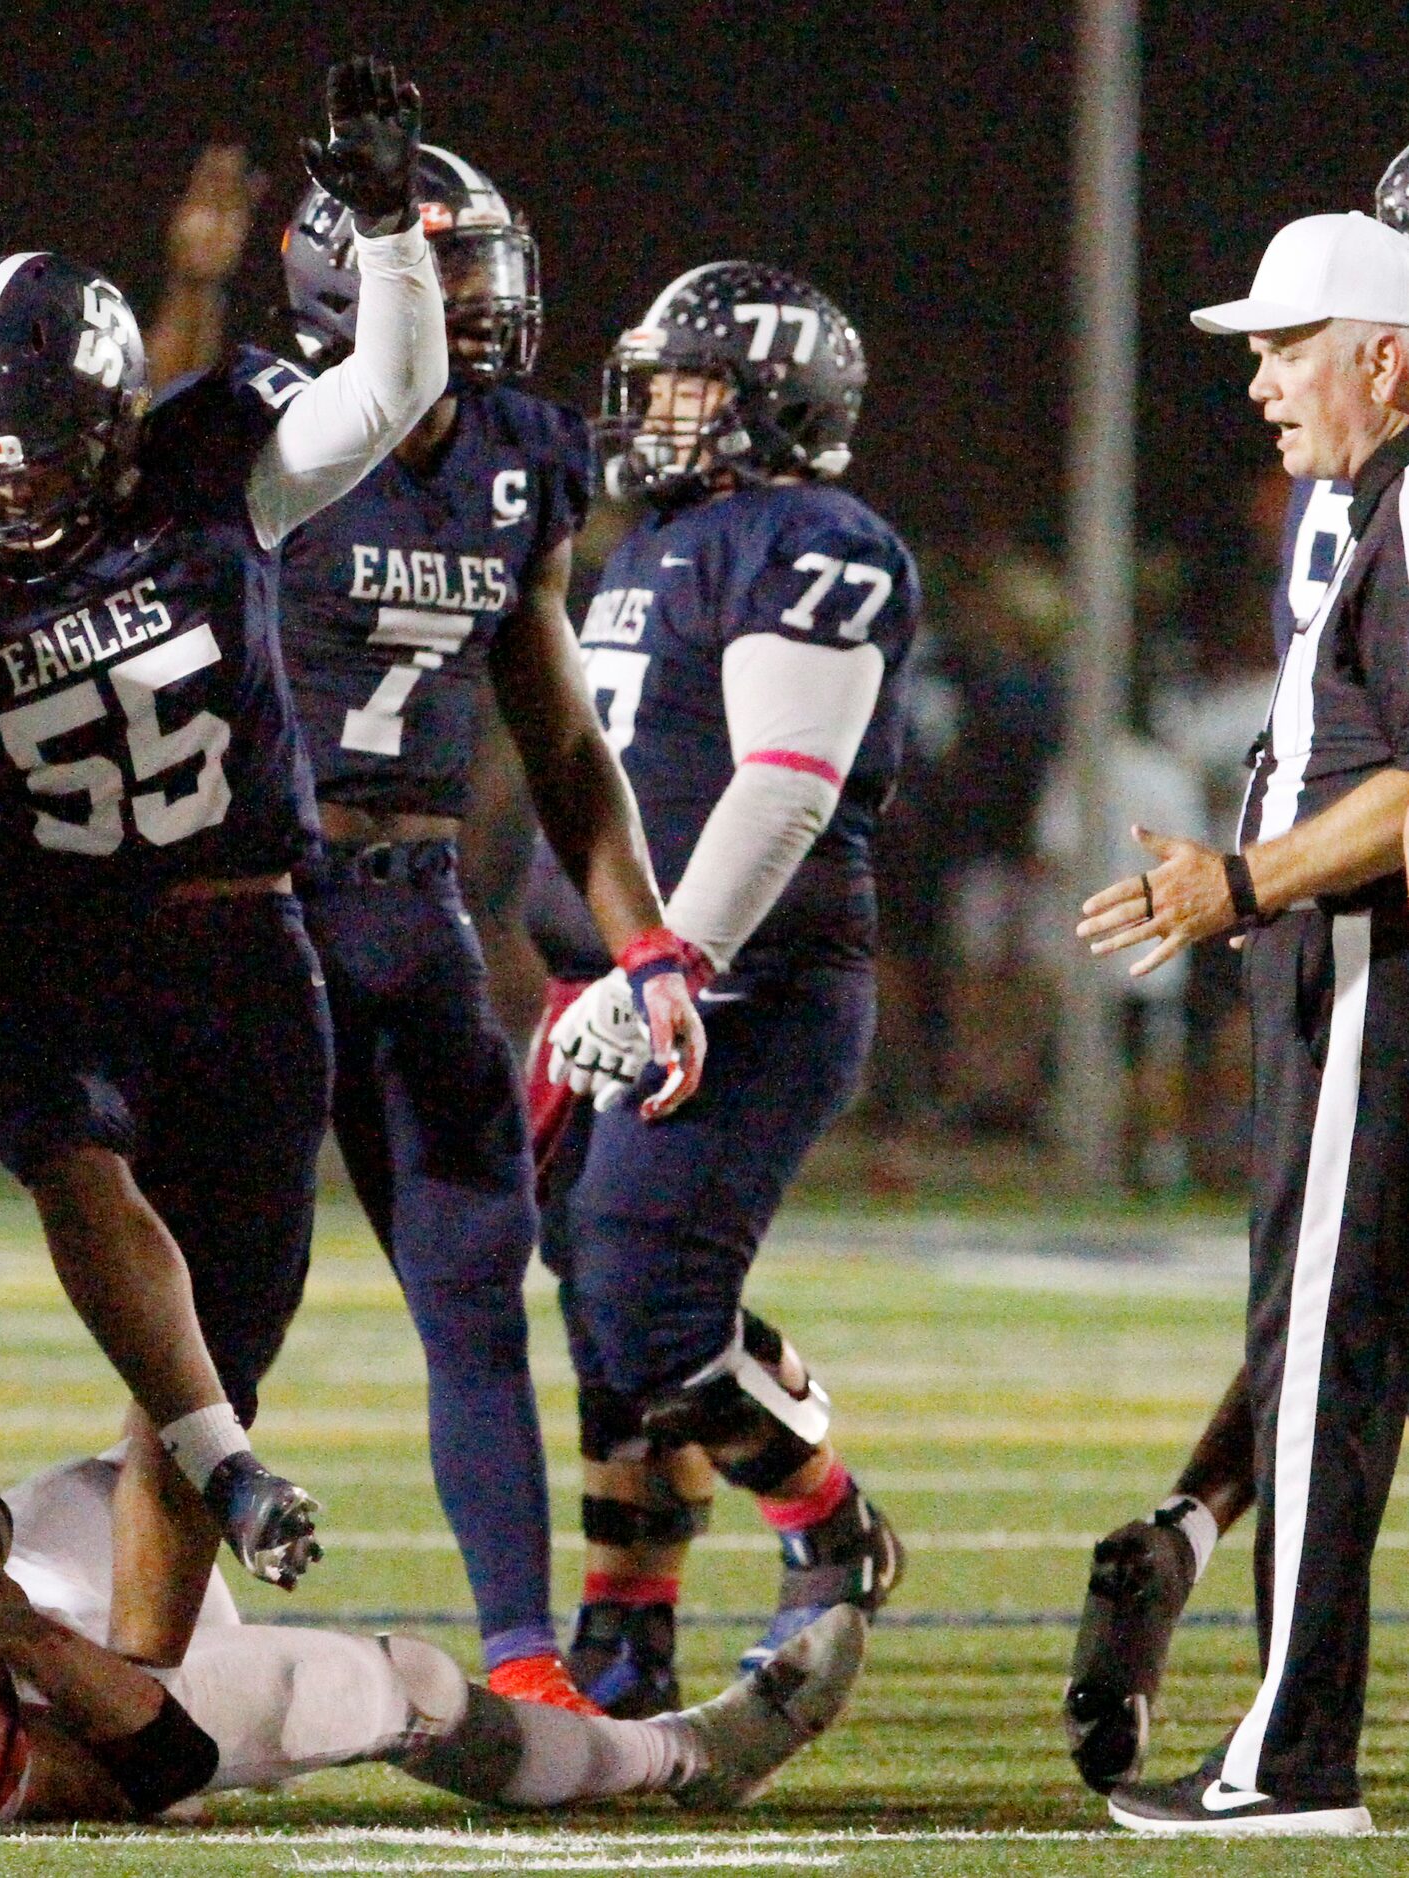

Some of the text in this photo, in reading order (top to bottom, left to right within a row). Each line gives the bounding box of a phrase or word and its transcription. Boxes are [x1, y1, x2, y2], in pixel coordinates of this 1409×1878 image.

[733, 303, 821, 364] 77
[492, 469, 528, 518] C
[348, 544, 507, 612] EAGLES
[781, 552, 891, 641] 77
[340, 607, 474, 757] 7
